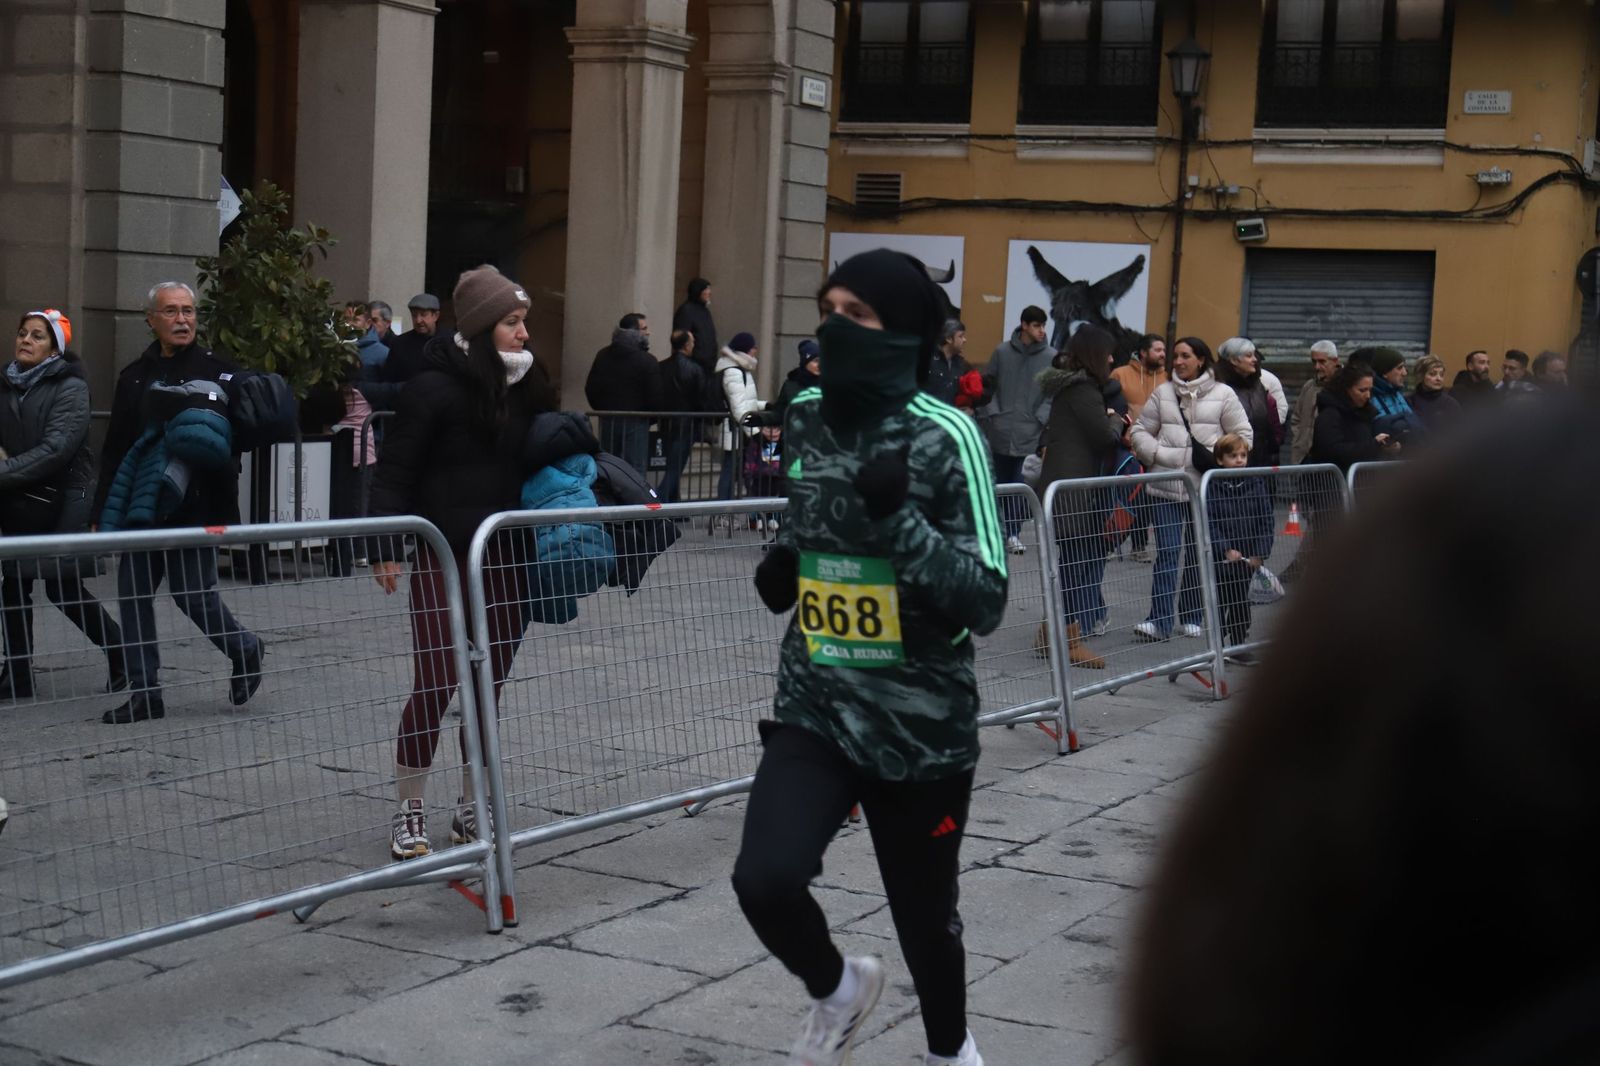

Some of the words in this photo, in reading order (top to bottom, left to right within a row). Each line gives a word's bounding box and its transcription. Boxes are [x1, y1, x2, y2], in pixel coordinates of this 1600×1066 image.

[809, 82, 824, 92] PLAZA
[801, 590, 883, 638] 668
[822, 644, 850, 659] CAJA
[853, 647, 898, 660] RURAL
